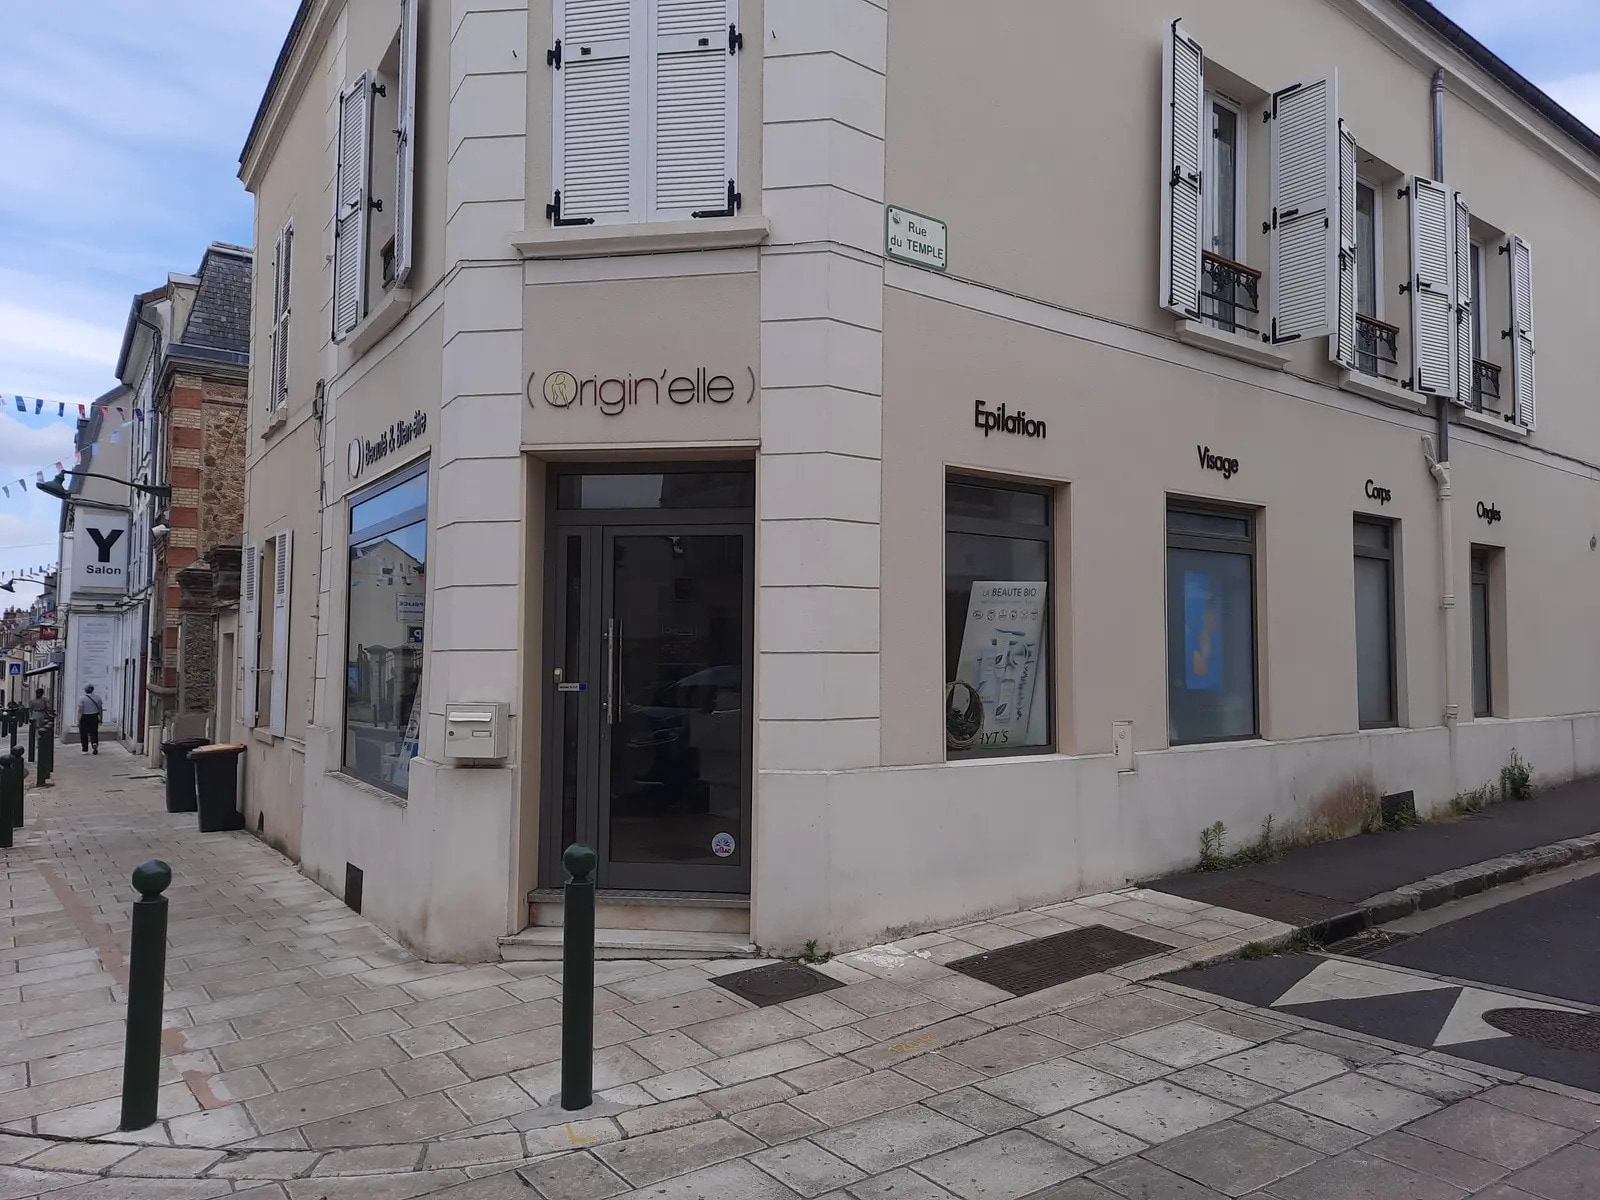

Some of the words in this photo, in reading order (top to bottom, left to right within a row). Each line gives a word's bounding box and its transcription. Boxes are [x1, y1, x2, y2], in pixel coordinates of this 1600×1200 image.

[908, 221, 927, 237] Rue
[890, 235, 902, 247] du
[906, 239, 943, 260] TEMPLE
[975, 399, 1046, 439] Epilation
[389, 425, 396, 453] &
[1197, 444, 1239, 480] Visage
[1365, 479, 1391, 506] Corps
[1476, 501, 1501, 525] Ongles
[86, 528, 125, 563] Y
[86, 565, 121, 574] Salon
[992, 588, 1021, 597] BEAUTE
[1023, 587, 1037, 597] BIO
